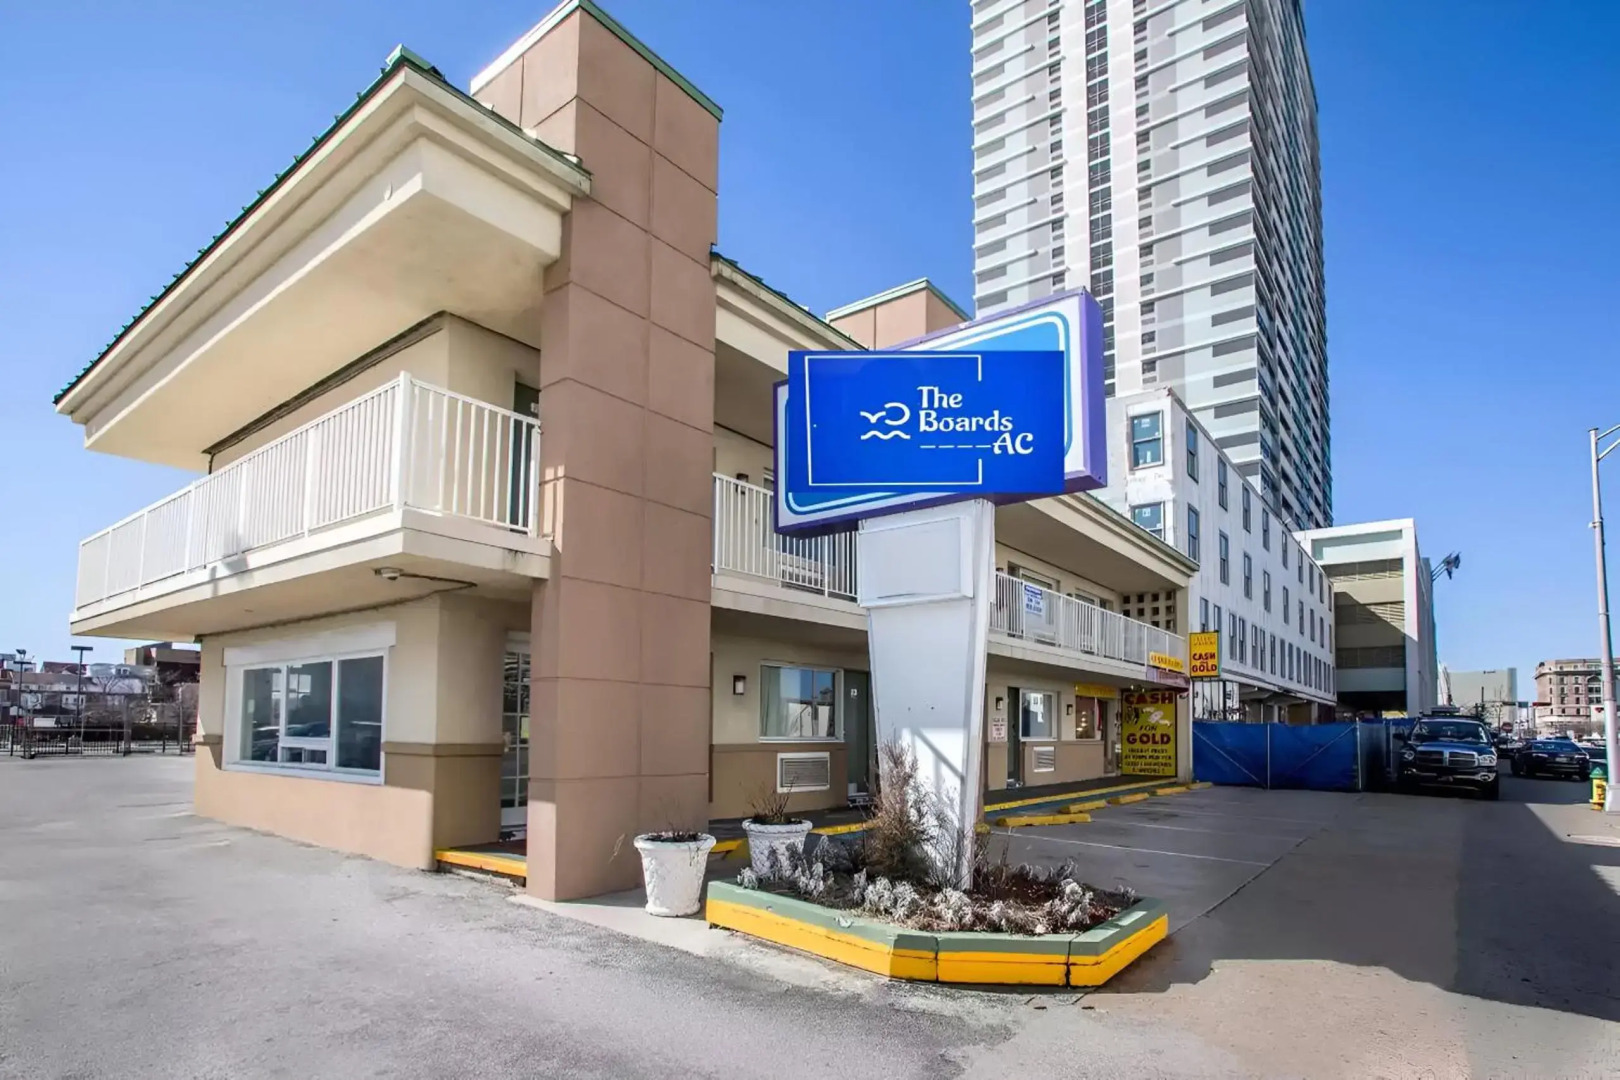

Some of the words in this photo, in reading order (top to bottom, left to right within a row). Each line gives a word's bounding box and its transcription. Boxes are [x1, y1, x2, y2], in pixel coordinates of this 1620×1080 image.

[917, 386, 962, 409] The
[919, 410, 1013, 432] Boards
[992, 432, 1034, 455] AC
[1192, 652, 1216, 661] CASH
[1191, 662, 1217, 673] GOLD
[1124, 692, 1174, 705] CASH
[1126, 733, 1172, 745] GOLD
